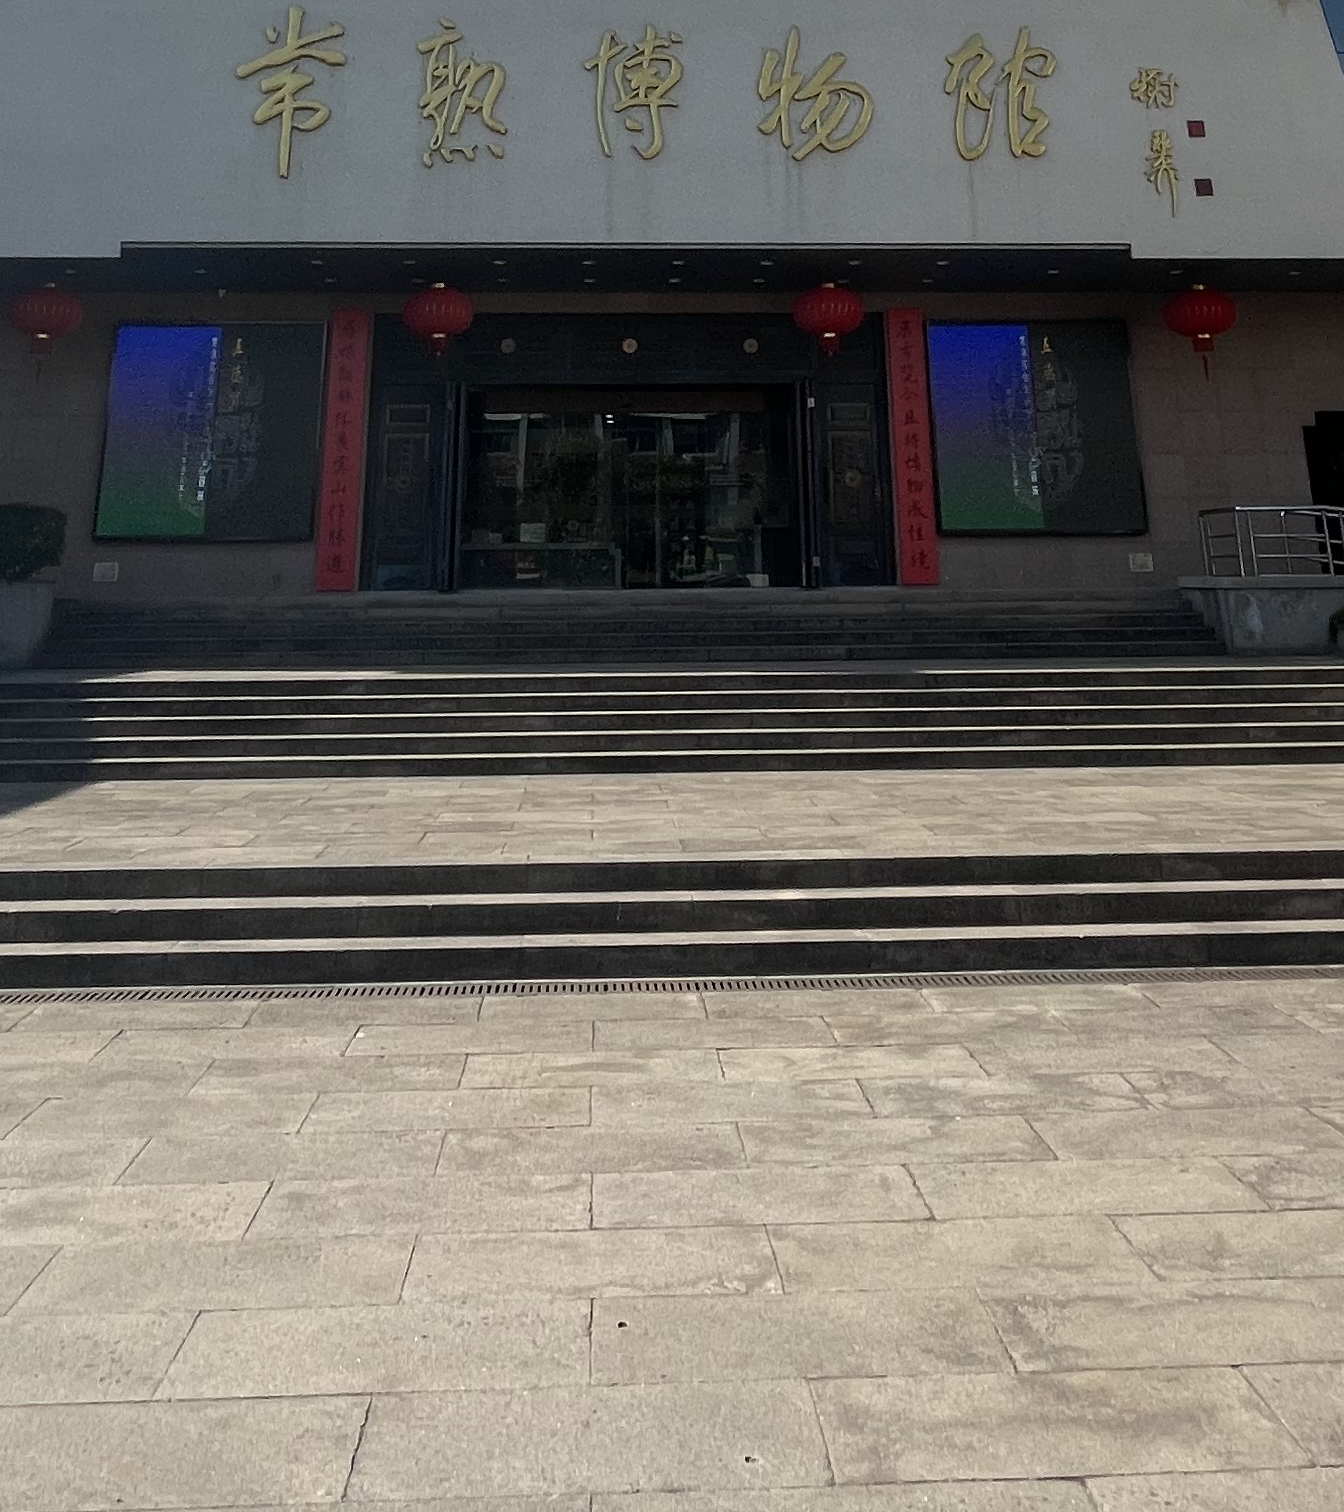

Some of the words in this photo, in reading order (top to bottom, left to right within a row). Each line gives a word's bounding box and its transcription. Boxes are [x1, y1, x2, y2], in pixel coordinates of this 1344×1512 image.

[236, 5, 1055, 180] 常熟博物馆
